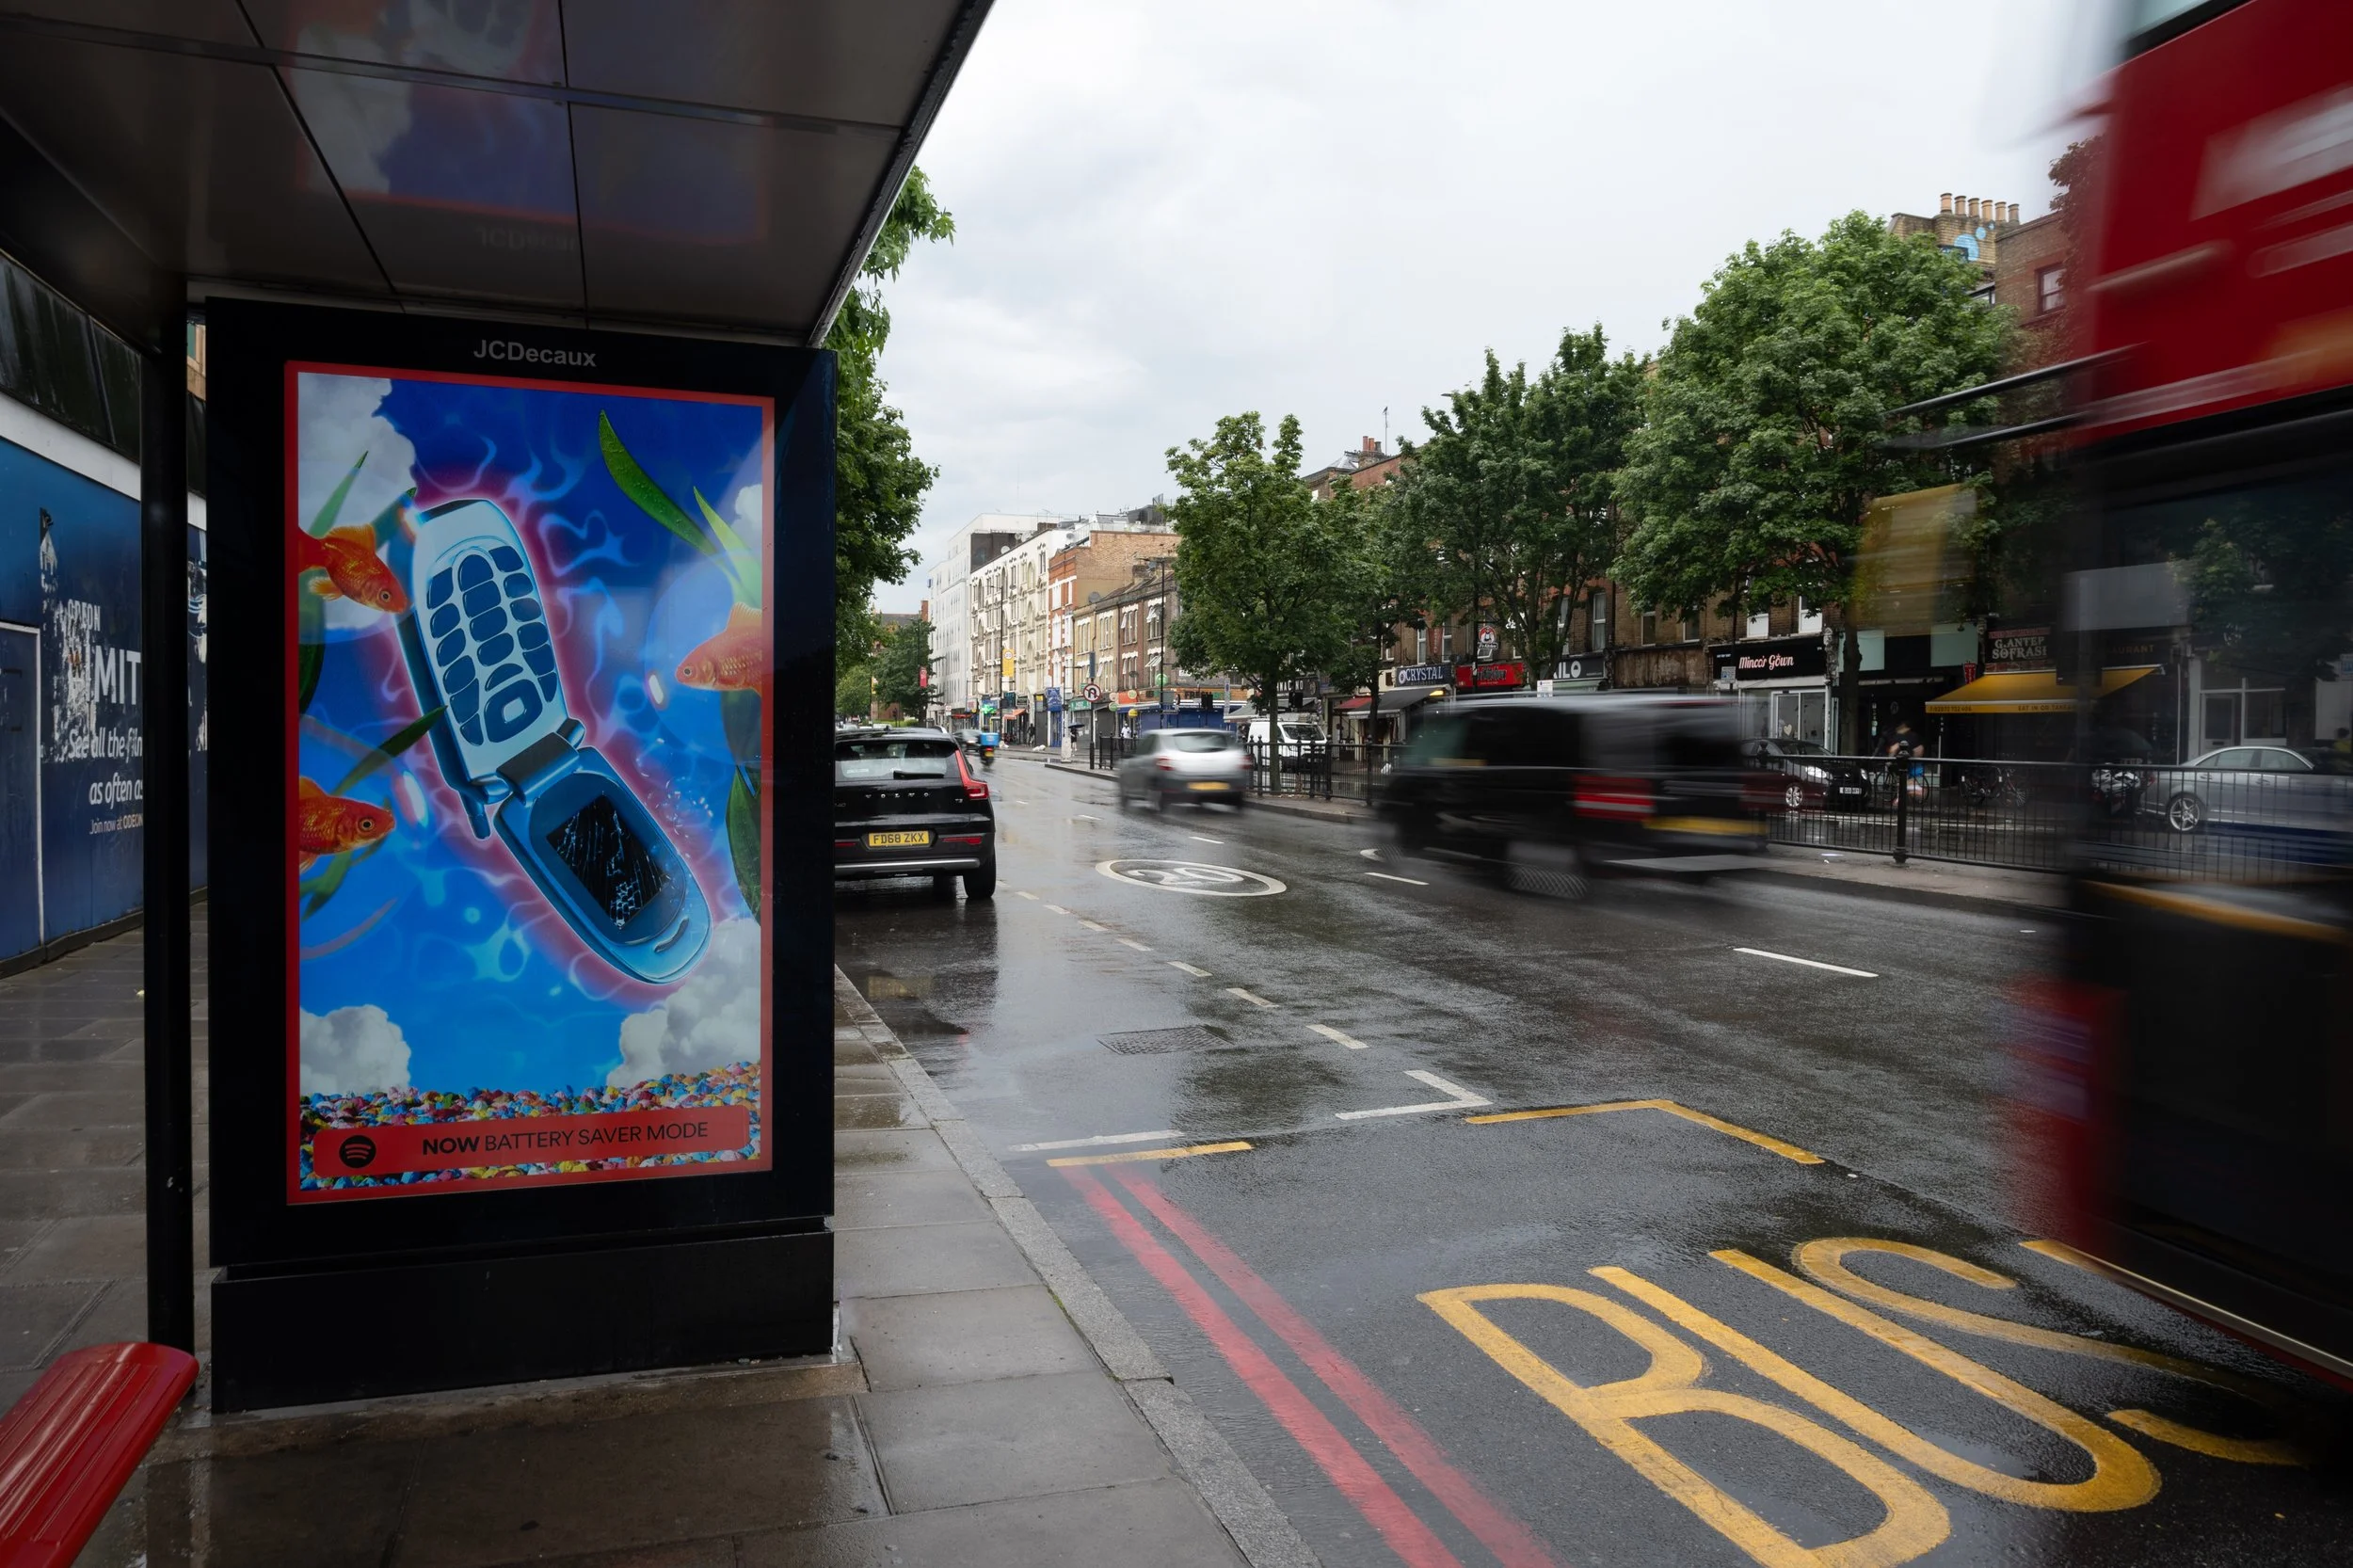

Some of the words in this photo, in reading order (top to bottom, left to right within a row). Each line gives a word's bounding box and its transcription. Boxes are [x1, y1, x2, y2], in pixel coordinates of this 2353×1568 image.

[472, 339, 598, 368] JCDecaux
[1553, 660, 1582, 679] ILO
[1769, 653, 1794, 670] Gown
[1406, 665, 1444, 681] CRYSTAL
[107, 727, 125, 758] the
[88, 781, 104, 806] as
[104, 772, 132, 809] often
[89, 817, 104, 835] Join
[104, 820, 116, 833] now
[117, 817, 122, 830] at
[873, 834, 902, 845] FD68
[904, 832, 925, 843] ZKX
[1127, 867, 1244, 886] 20
[422, 1135, 483, 1156] NOW
[484, 1129, 572, 1153] BATTERY
[577, 1125, 642, 1147] SAVER
[646, 1121, 709, 1144] MODE
[1416, 1235, 2306, 1568] BUS
